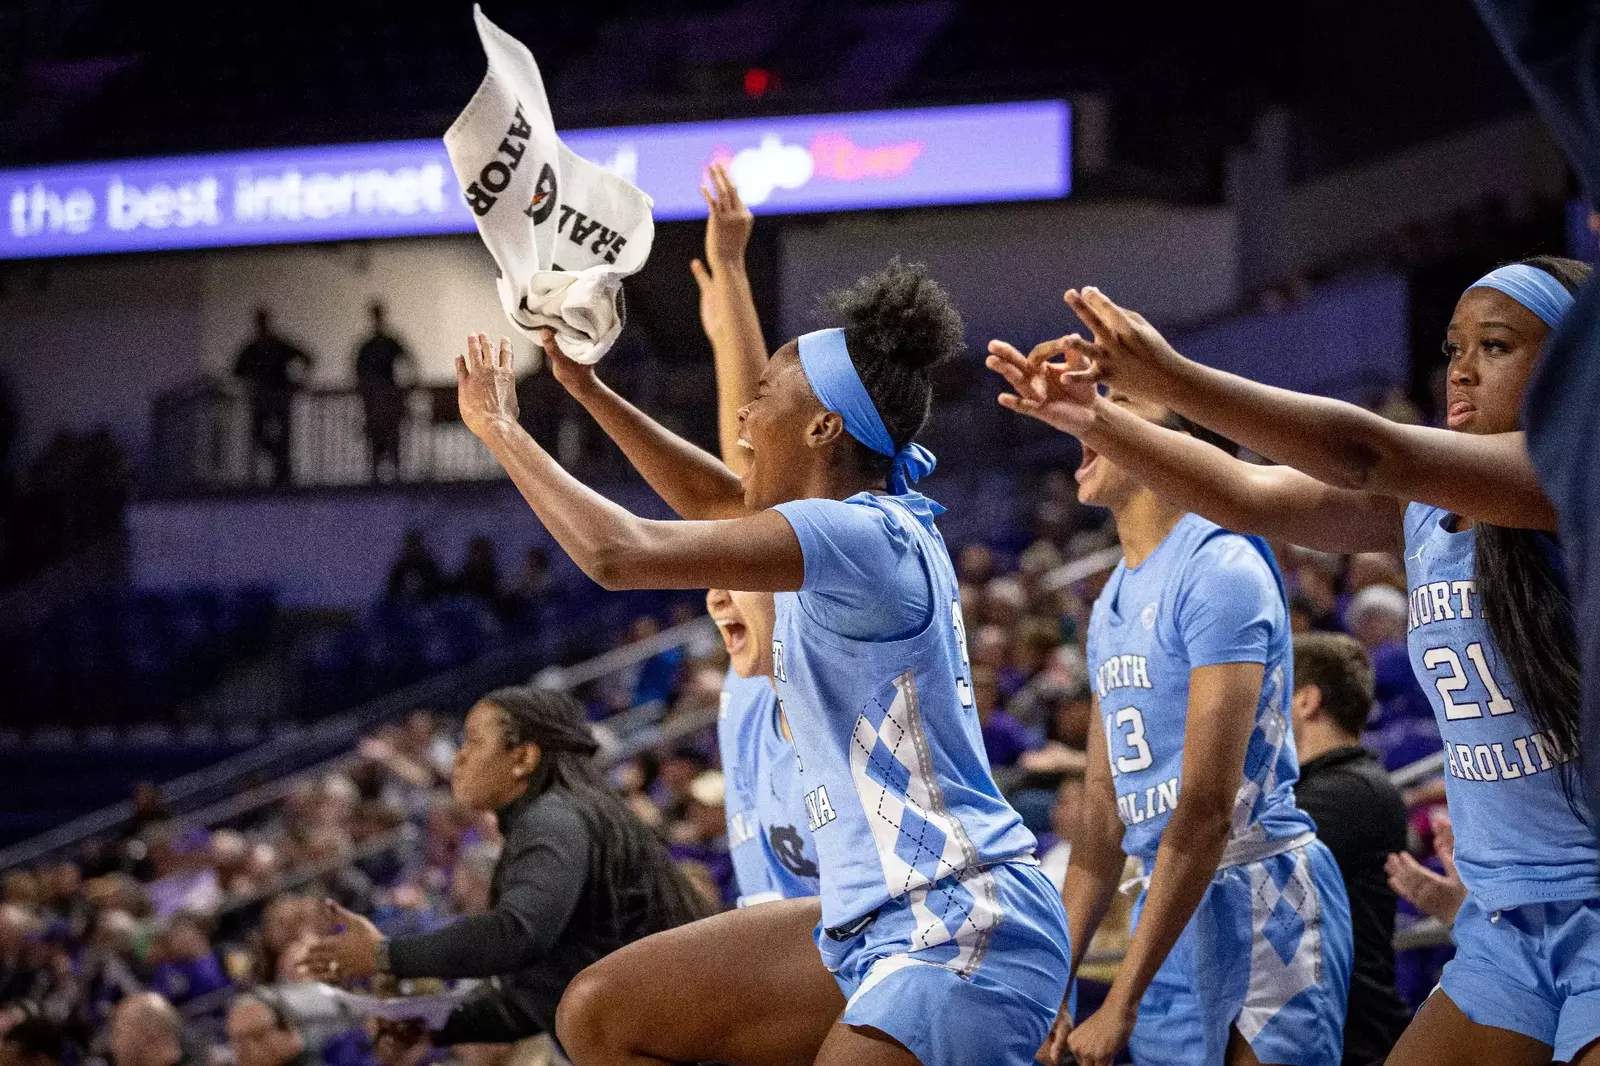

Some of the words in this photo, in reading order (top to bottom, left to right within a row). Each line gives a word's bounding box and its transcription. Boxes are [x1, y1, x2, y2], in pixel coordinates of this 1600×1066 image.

[11, 182, 95, 237] the
[107, 175, 219, 231] best
[236, 166, 444, 222] internet
[1408, 580, 1491, 635] NORT
[1422, 642, 1517, 722] 21
